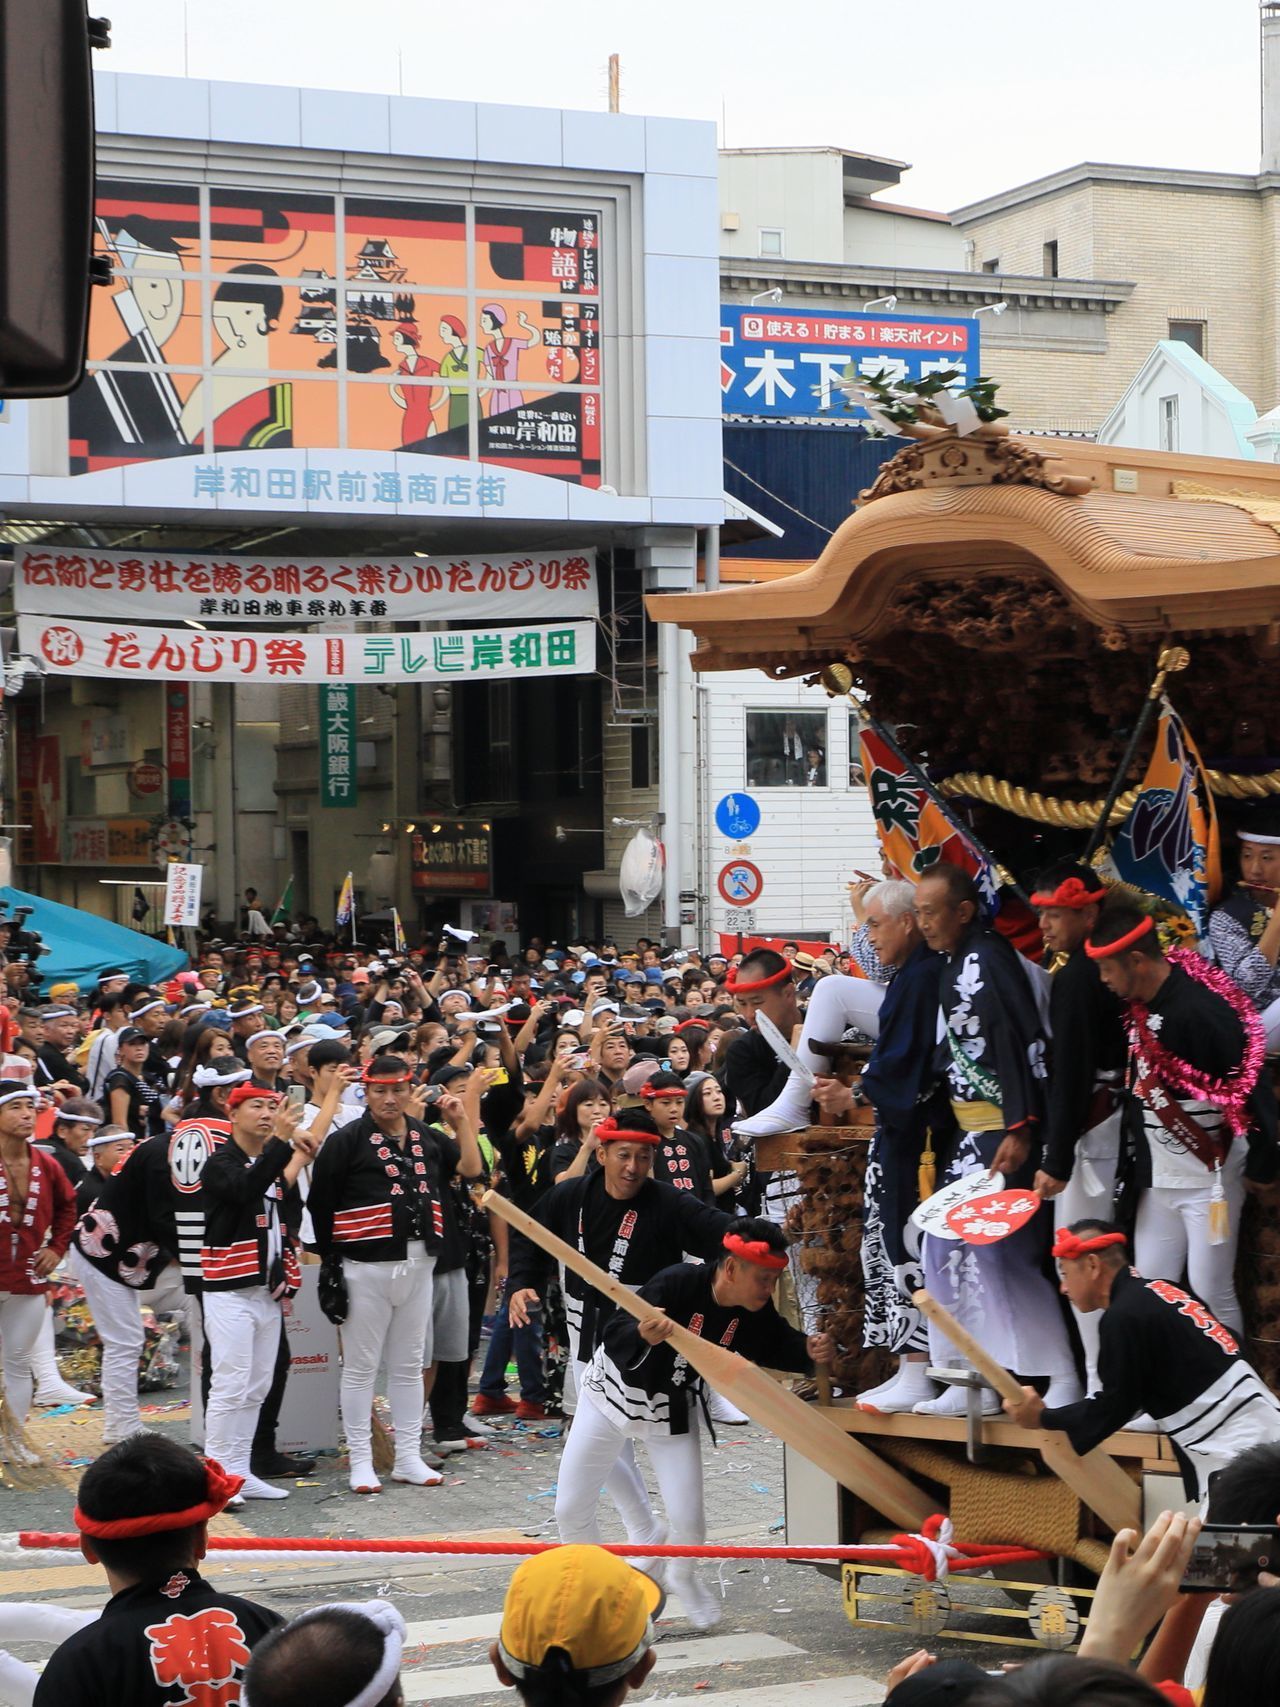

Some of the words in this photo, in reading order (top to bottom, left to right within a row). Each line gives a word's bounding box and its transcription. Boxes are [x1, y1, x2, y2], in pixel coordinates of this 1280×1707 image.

[193, 465, 507, 507] 岸和田駅前通商店街
[22, 551, 591, 596] 伝統と勇壮を誇る明るく楽しいだんじり祭
[48, 629, 77, 662] 祝
[103, 632, 307, 676] だんじり祭
[363, 629, 576, 675] テレビ岸和田
